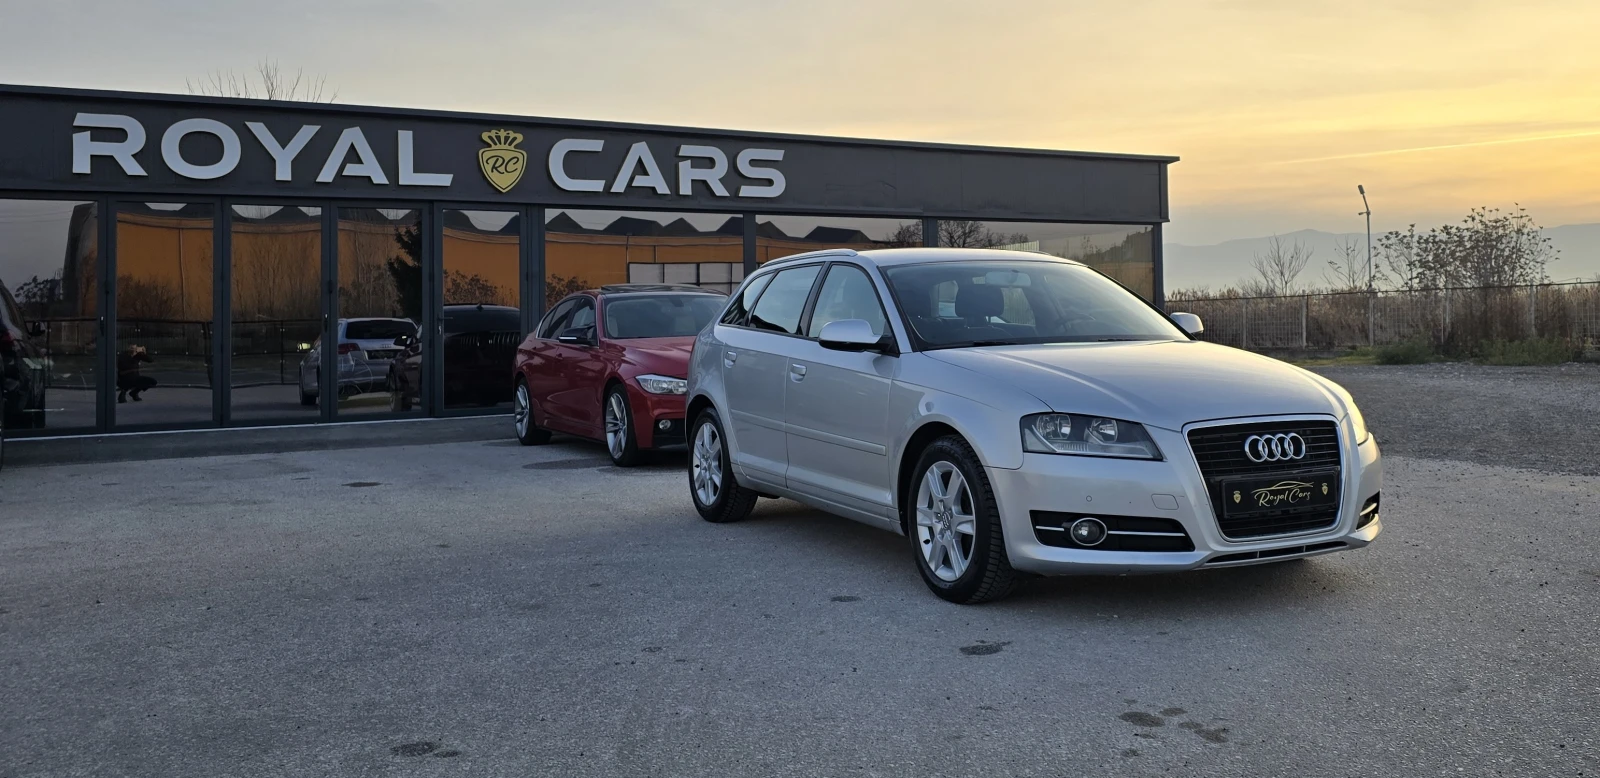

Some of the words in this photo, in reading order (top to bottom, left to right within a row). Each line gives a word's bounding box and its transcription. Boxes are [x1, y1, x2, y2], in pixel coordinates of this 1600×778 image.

[72, 112, 452, 187] ROYAL
[549, 138, 786, 198] CARS
[485, 155, 520, 174] RC
[1254, 490, 1288, 506] Royal
[1288, 488, 1311, 503] Cars
